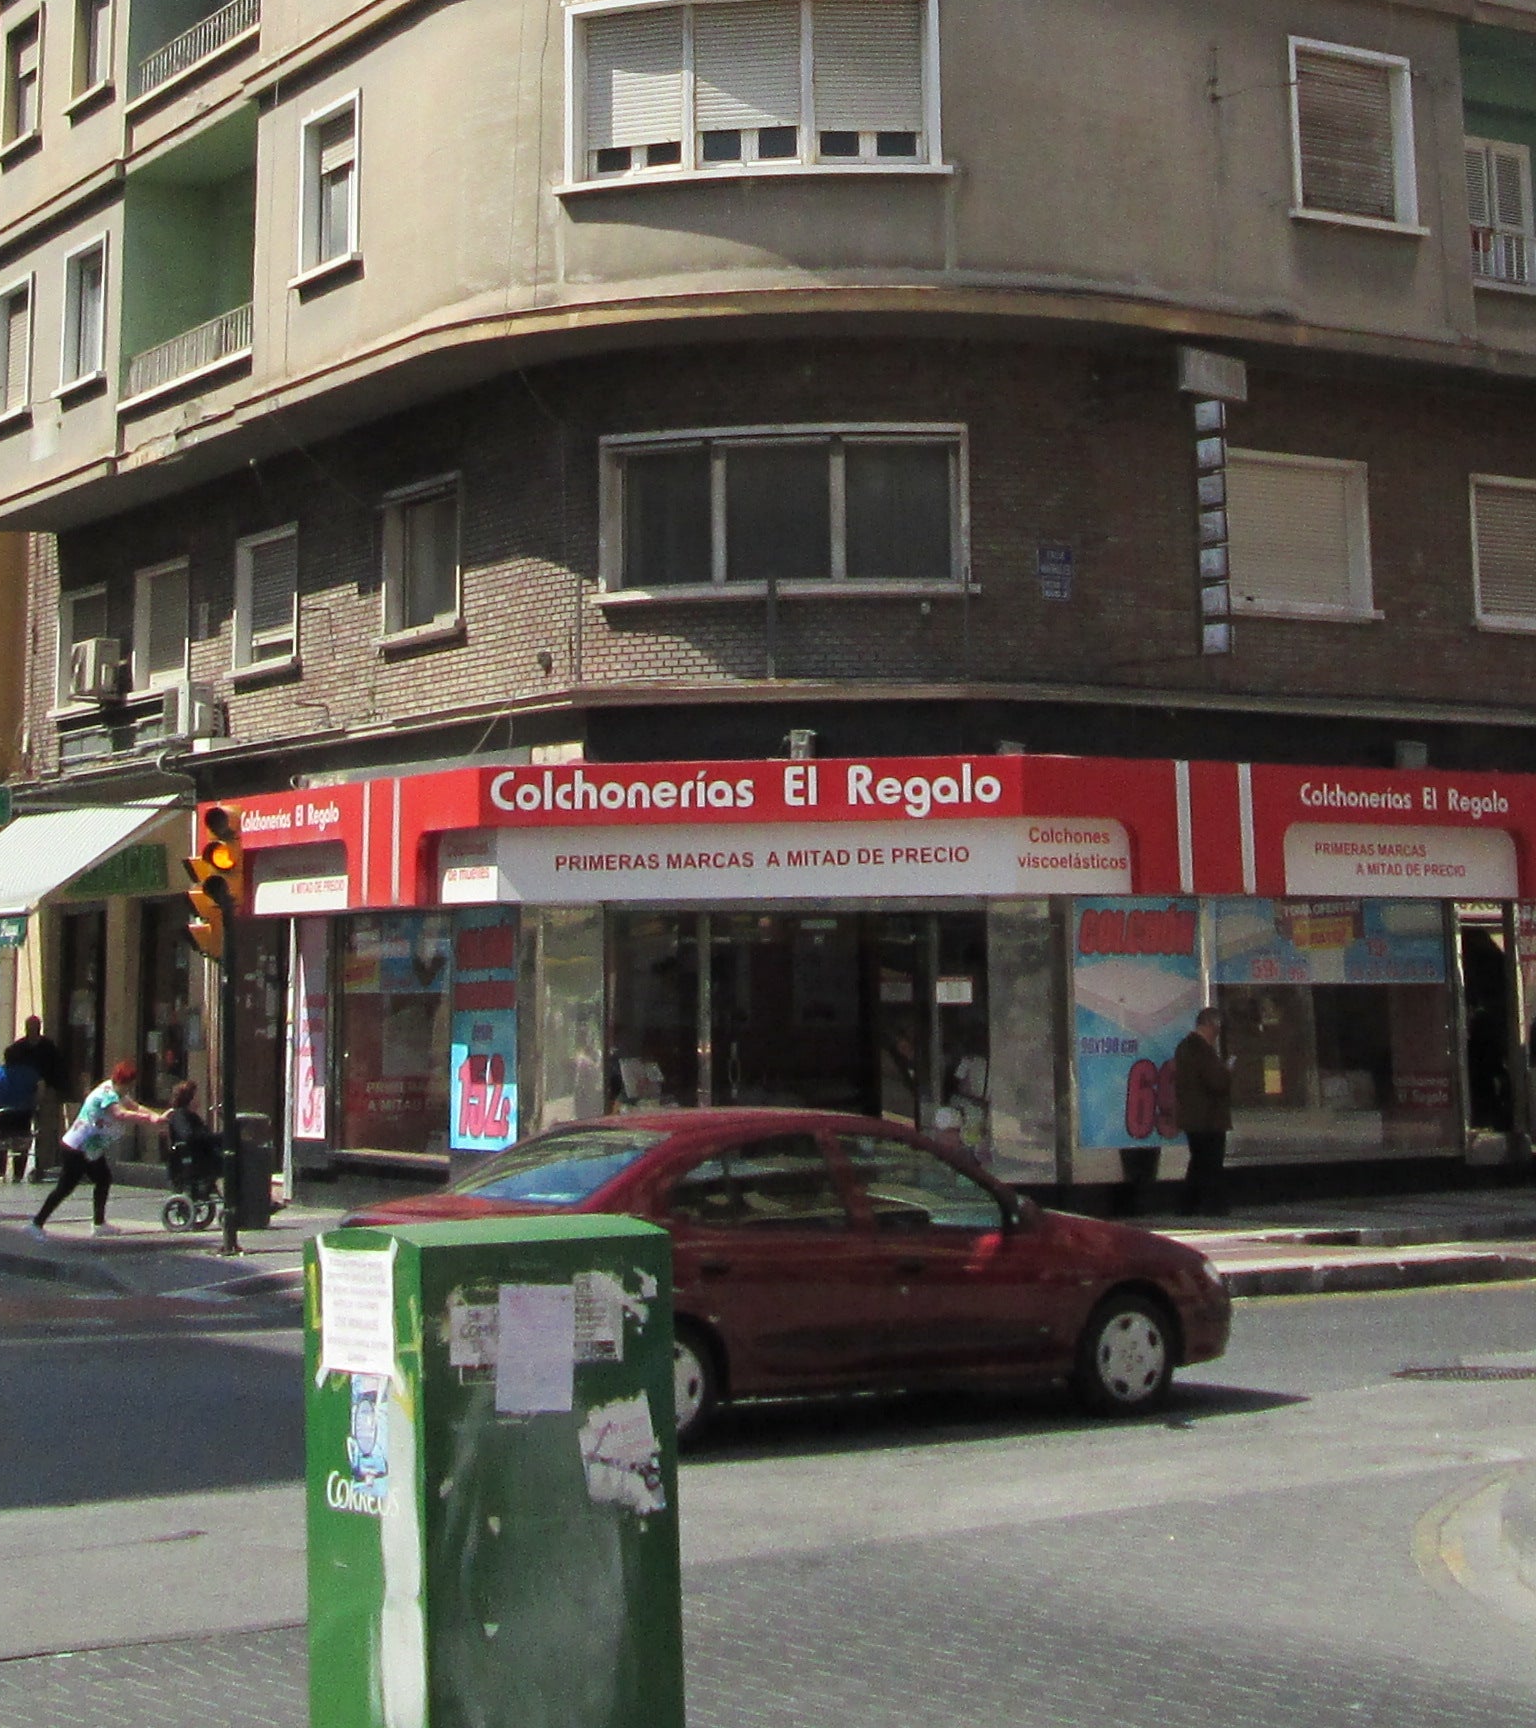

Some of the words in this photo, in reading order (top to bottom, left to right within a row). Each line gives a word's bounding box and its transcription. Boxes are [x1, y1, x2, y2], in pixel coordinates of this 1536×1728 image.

[490, 770, 754, 811] Colchonerías
[784, 765, 818, 807] El
[848, 762, 1002, 818] Regalo
[1300, 783, 1412, 810] Colchonerías
[1422, 786, 1438, 811] El
[1448, 788, 1509, 820] Regalo
[295, 804, 305, 827] El
[307, 800, 340, 832] Regalo
[1028, 826, 1111, 845] Colchones
[555, 853, 660, 872] PRIMERAS
[666, 850, 754, 870] MARCAS
[767, 851, 781, 868] A
[787, 848, 851, 868] MITAD
[857, 847, 885, 866] DE
[891, 845, 970, 865] PRECIO
[1314, 841, 1375, 857] PRIMERAS
[1377, 843, 1427, 858] MARCAS
[1017, 852, 1128, 871] viscoelásticos
[1356, 863, 1365, 876] A
[1367, 863, 1402, 877] MITAD
[1406, 864, 1422, 877] DE
[1424, 864, 1466, 878] PRECIO
